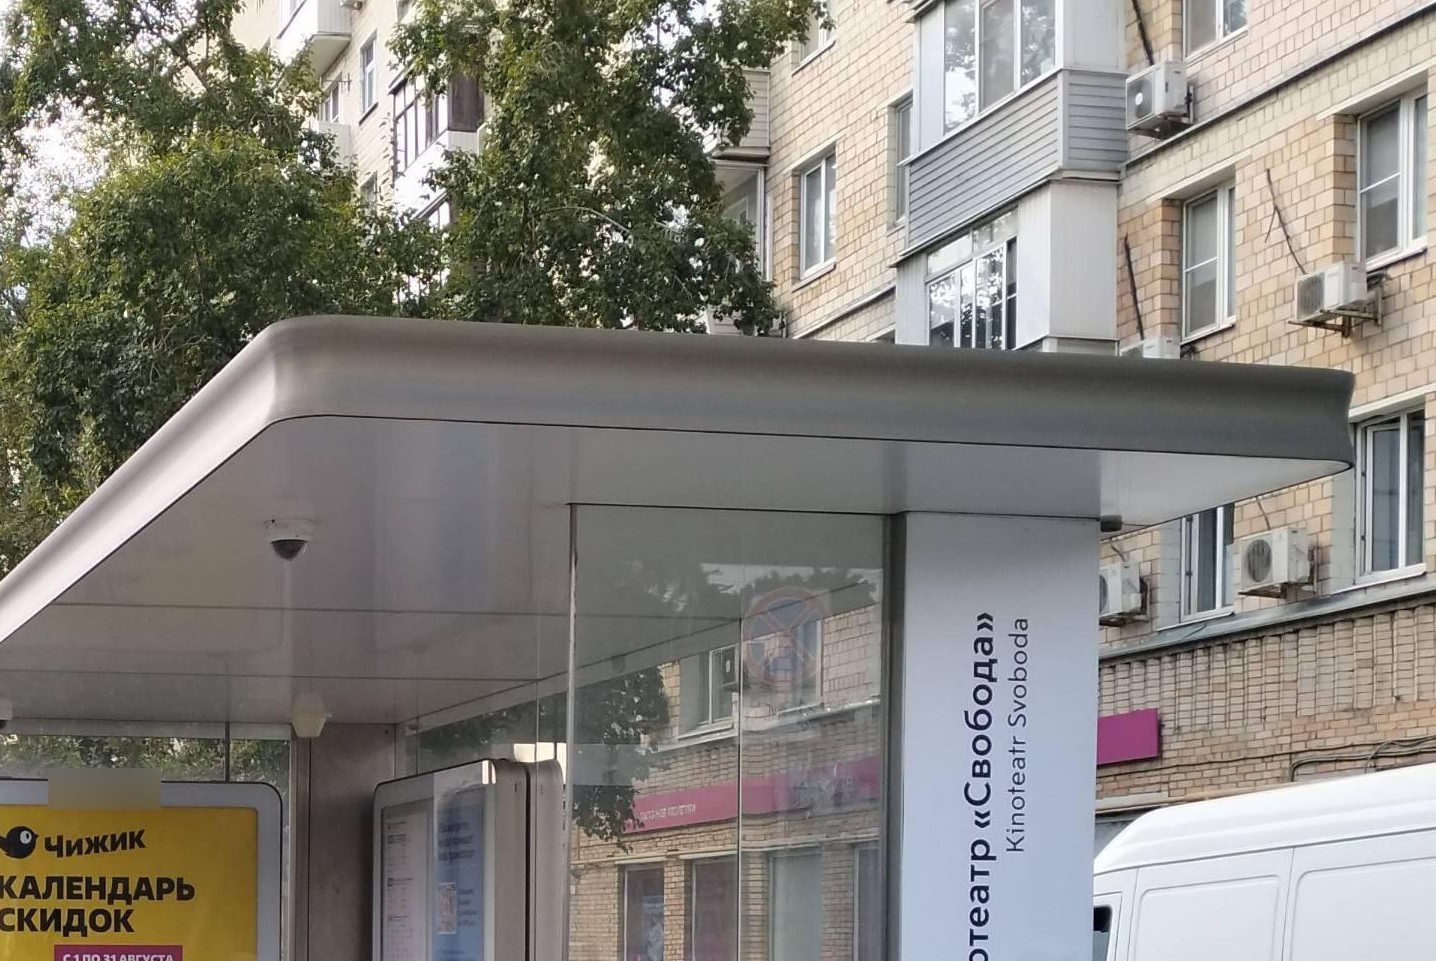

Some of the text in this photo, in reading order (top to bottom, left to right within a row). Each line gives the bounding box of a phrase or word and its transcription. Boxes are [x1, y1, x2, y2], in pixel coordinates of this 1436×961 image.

[963, 611, 999, 829] «Свобода»
[1005, 617, 1030, 852] Kinoteatr Svoboda
